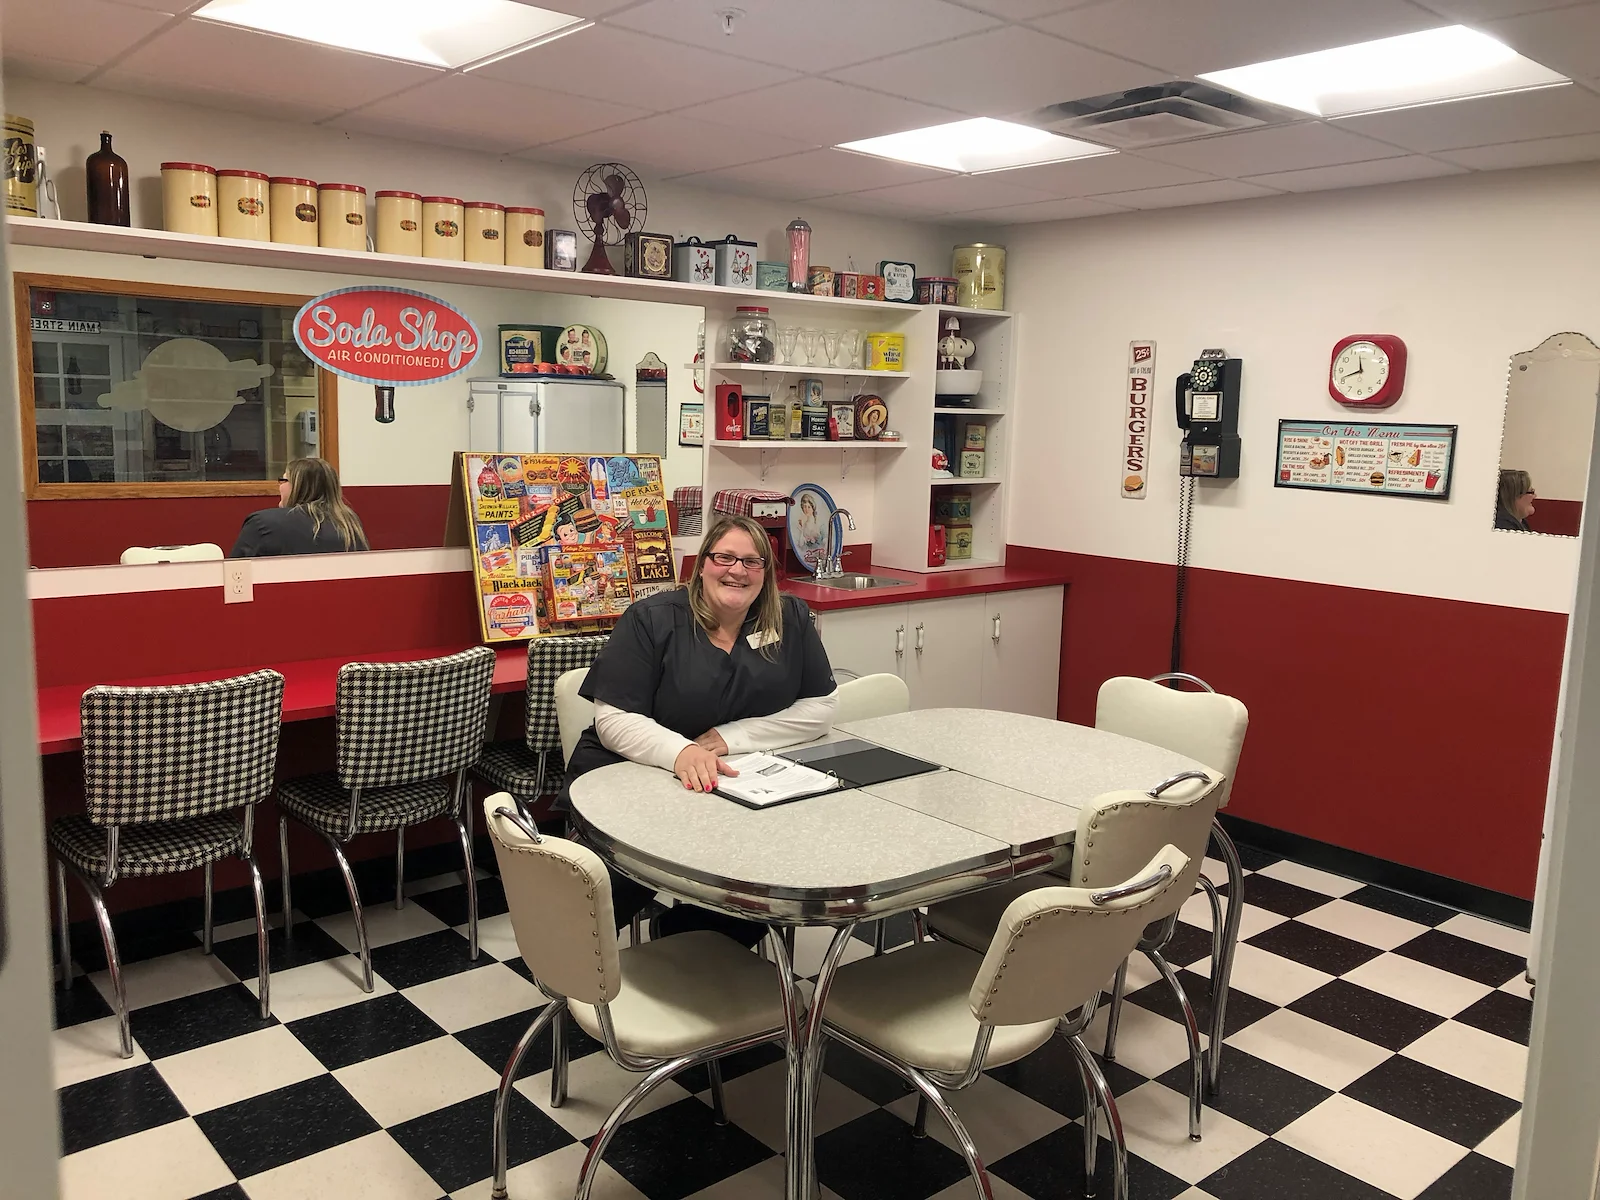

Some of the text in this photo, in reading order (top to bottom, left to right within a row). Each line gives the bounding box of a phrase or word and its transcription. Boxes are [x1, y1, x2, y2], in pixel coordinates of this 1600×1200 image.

[307, 305, 476, 369] Soda Shop
[328, 350, 444, 368] AIR CONDITIONED!
[1127, 377, 1148, 472] BURGERS
[1322, 426, 1400, 438] On the Menu
[626, 490, 636, 498] DE
[638, 484, 660, 494] KALB
[643, 498, 661, 506] Coffee
[510, 511, 537, 528] HEINZ
[635, 530, 664, 540] WELCOME
[640, 565, 670, 579] LAKE
[492, 580, 519, 592] Black
[521, 579, 542, 588] Jack
[488, 604, 532, 619] Carhartt
